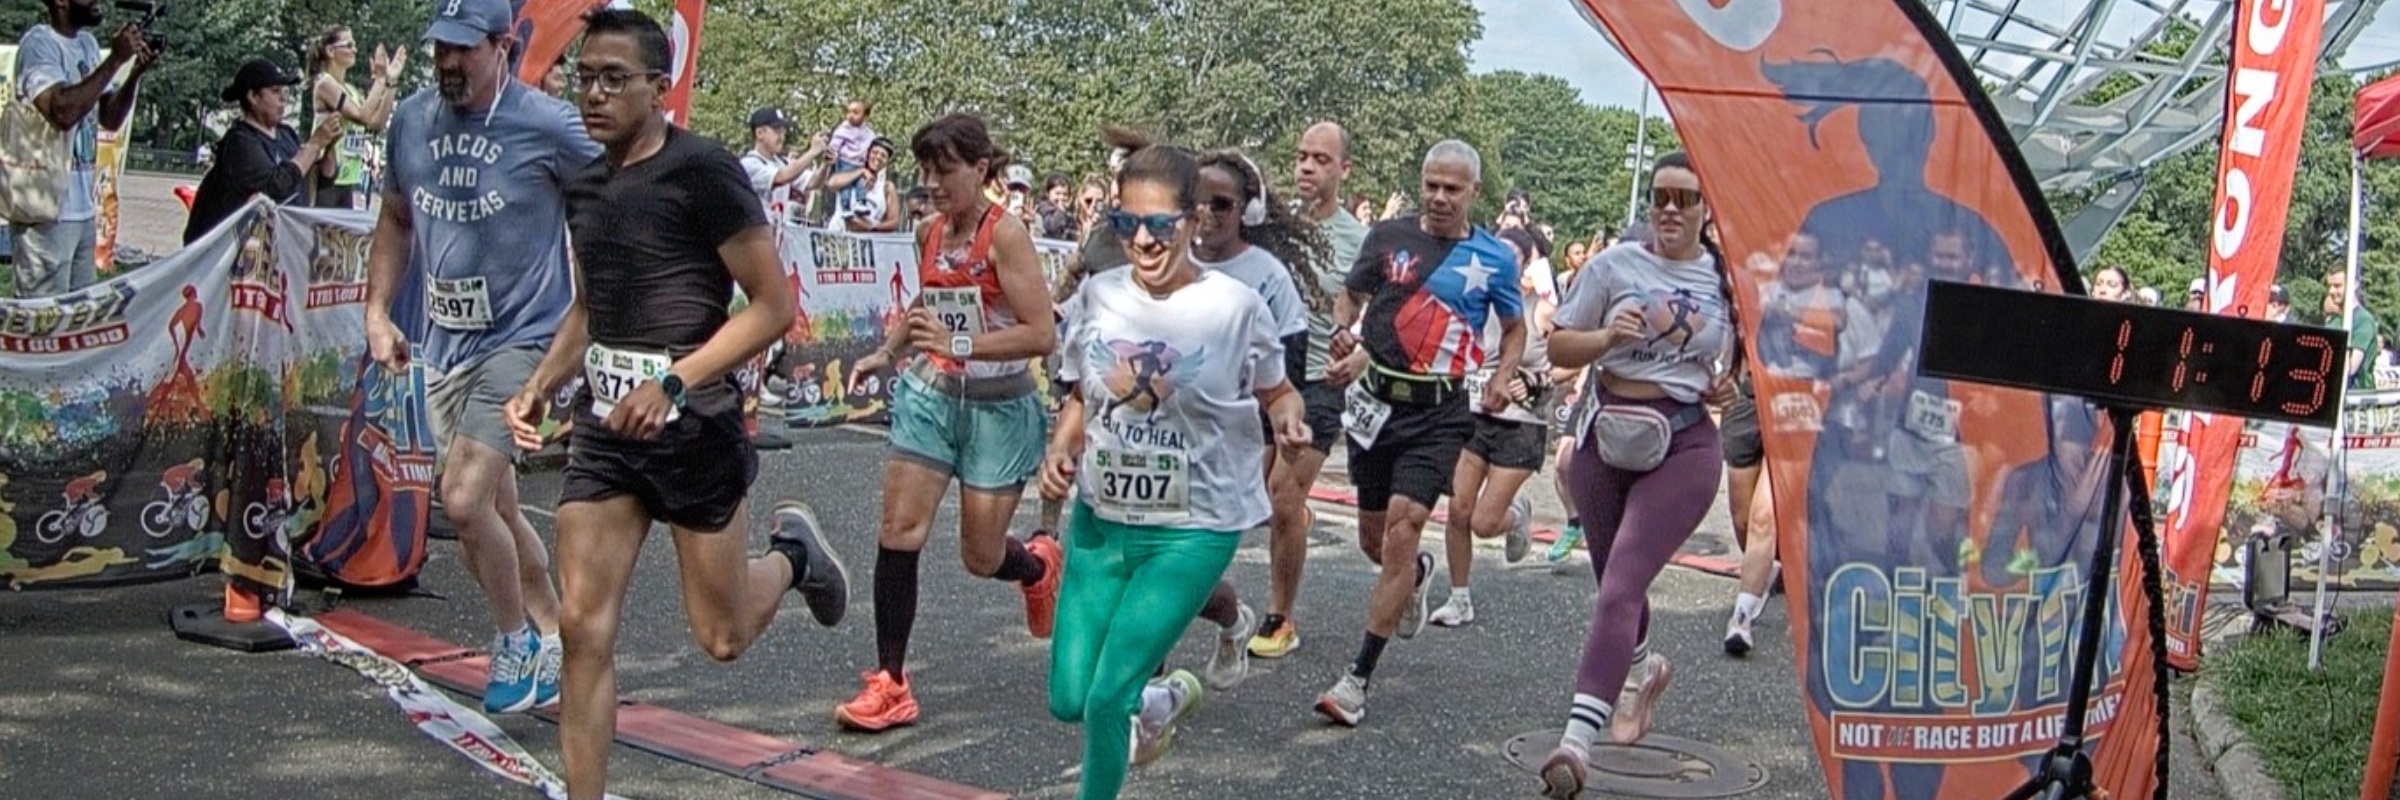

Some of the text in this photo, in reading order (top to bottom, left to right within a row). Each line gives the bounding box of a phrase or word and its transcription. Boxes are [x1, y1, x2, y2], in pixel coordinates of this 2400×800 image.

[428, 133, 503, 164] TACOS
[438, 166, 478, 188] AND
[413, 186, 505, 222] CERVEZAS
[958, 292, 977, 306] 5K
[2109, 319, 2334, 416] 11:13
[1125, 424, 1143, 443] TO
[1148, 428, 1185, 449] HEAL
[1103, 472, 1171, 500] 3707
[1839, 723, 1884, 748] NOT
[1913, 726, 1972, 750] RACE
[1976, 722, 2019, 749] BUT
[2021, 720, 2032, 744] A
